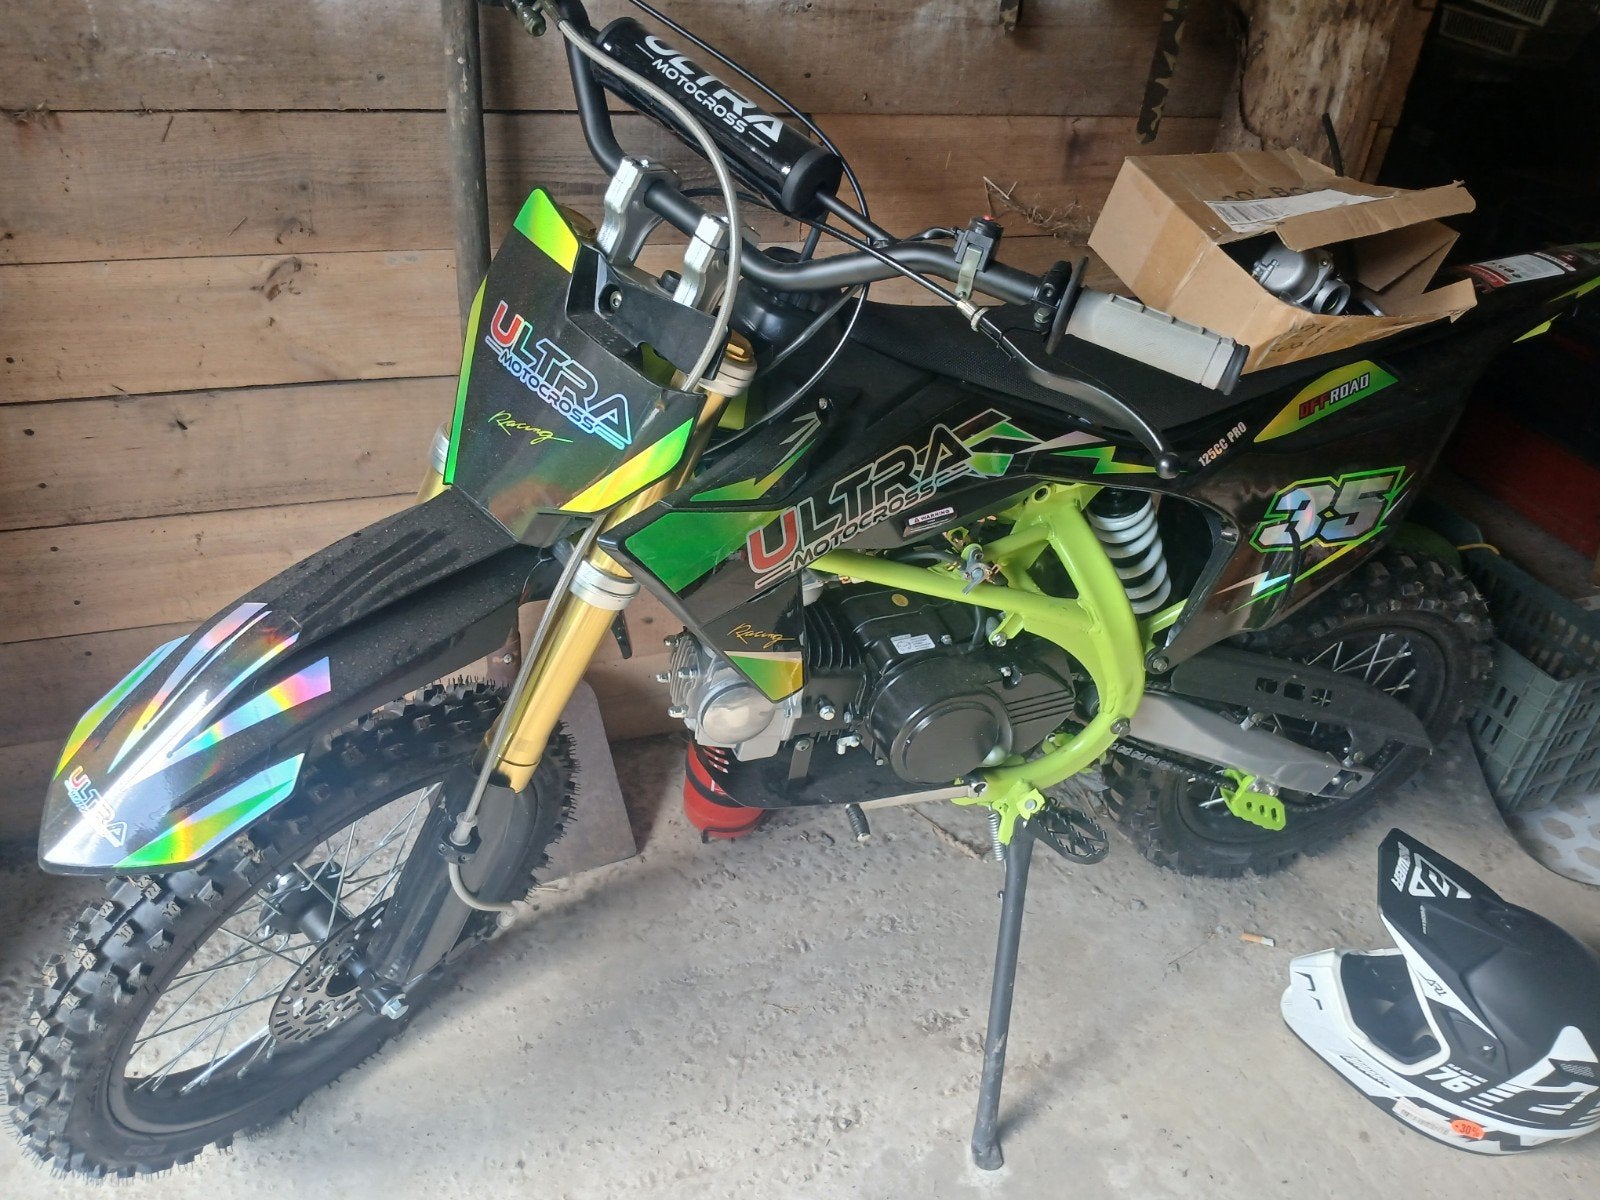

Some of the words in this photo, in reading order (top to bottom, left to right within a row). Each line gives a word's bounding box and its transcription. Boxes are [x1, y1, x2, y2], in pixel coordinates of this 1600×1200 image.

[652, 58, 748, 134] MOTOCROSS
[491, 300, 633, 445] ULTRA
[500, 348, 595, 433] MOTOCROSS
[488, 410, 573, 445] Racing
[1198, 438, 1228, 467] 125CC
[1228, 421, 1247, 443] PRO
[747, 423, 975, 574] ULTRA
[791, 480, 937, 573] MOTOCROSS
[920, 509, 950, 521] WARNING
[1253, 468, 1402, 551] 35
[727, 623, 795, 649] Racing
[1425, 1066, 1482, 1093] 76
